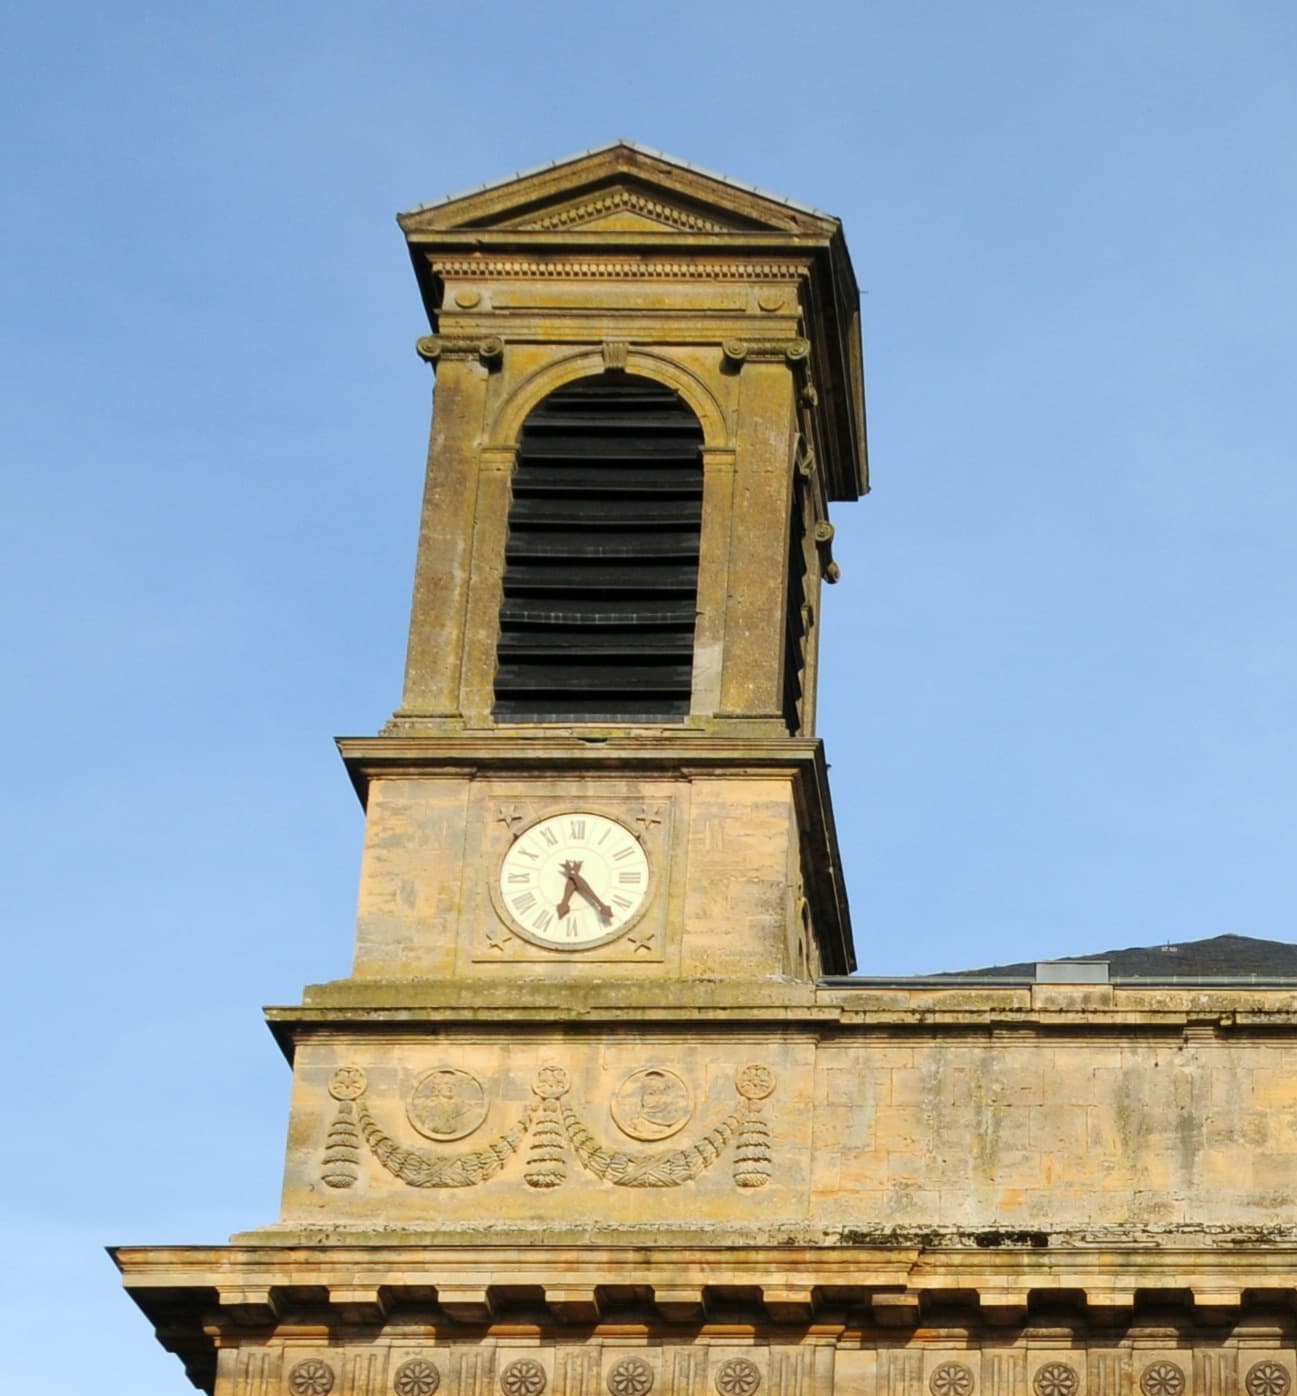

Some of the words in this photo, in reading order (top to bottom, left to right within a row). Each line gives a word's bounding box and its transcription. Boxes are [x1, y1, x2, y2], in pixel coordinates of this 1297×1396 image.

[570, 820, 586, 840] XII
[612, 846, 636, 862] II
[619, 872, 641, 884] III
